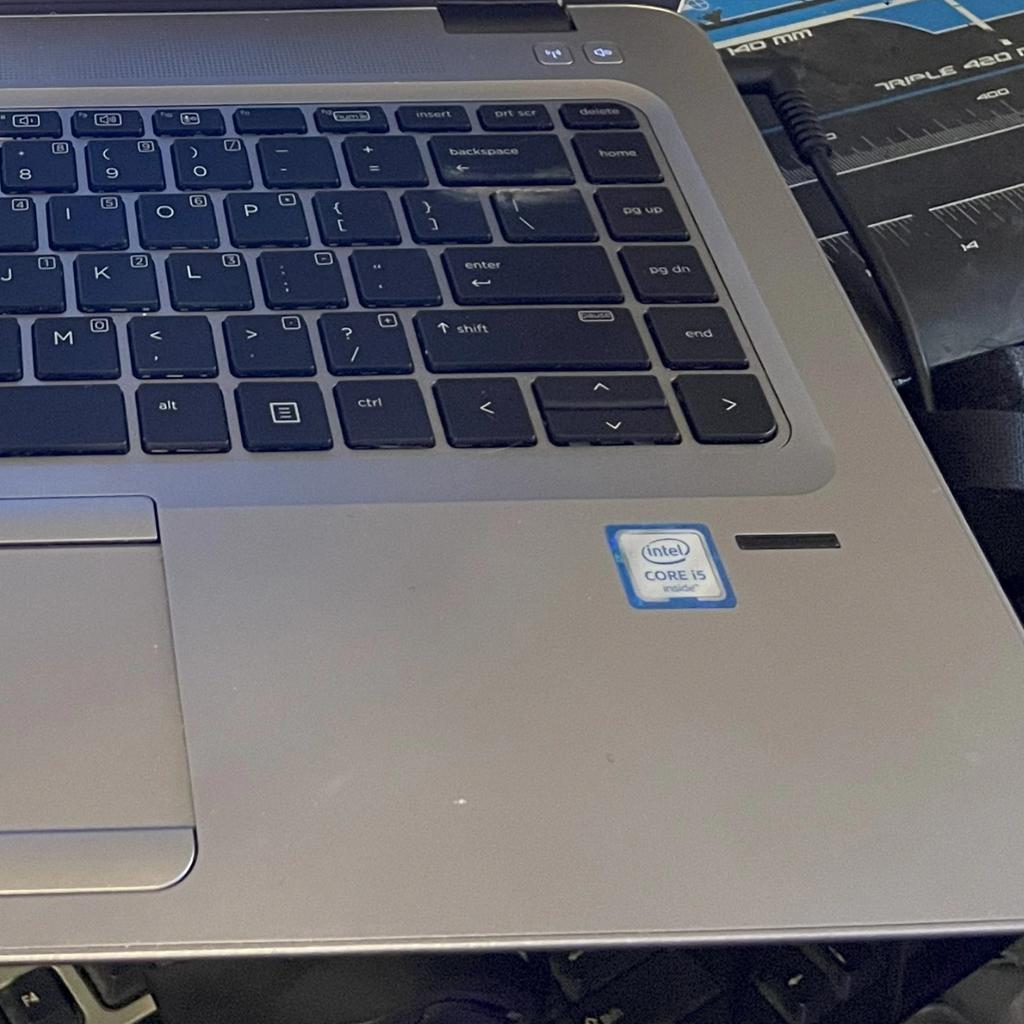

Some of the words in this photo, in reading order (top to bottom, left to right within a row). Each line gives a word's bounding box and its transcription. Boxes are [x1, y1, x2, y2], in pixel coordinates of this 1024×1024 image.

[727, 40, 767, 56] 140
[772, 29, 813, 46] mm
[874, 64, 957, 91] TRIPLE
[963, 51, 1013, 70] 420
[976, 87, 1011, 101] 400
[20, 169, 31, 179] 8
[106, 168, 118, 178] 9
[157, 206, 174, 218] O
[244, 205, 258, 216] P
[1, 268, 11, 281] J
[95, 267, 110, 279] K
[187, 266, 201, 278] L
[649, 267, 668, 275] pg
[672, 265, 690, 273] dn
[457, 324, 488, 333] shift
[685, 329, 712, 337] end
[54, 331, 73, 345] M
[159, 401, 177, 410] alt
[358, 398, 381, 407] ctrl
[647, 544, 684, 558] intel
[645, 570, 689, 581] CORE
[691, 569, 706, 581] i5
